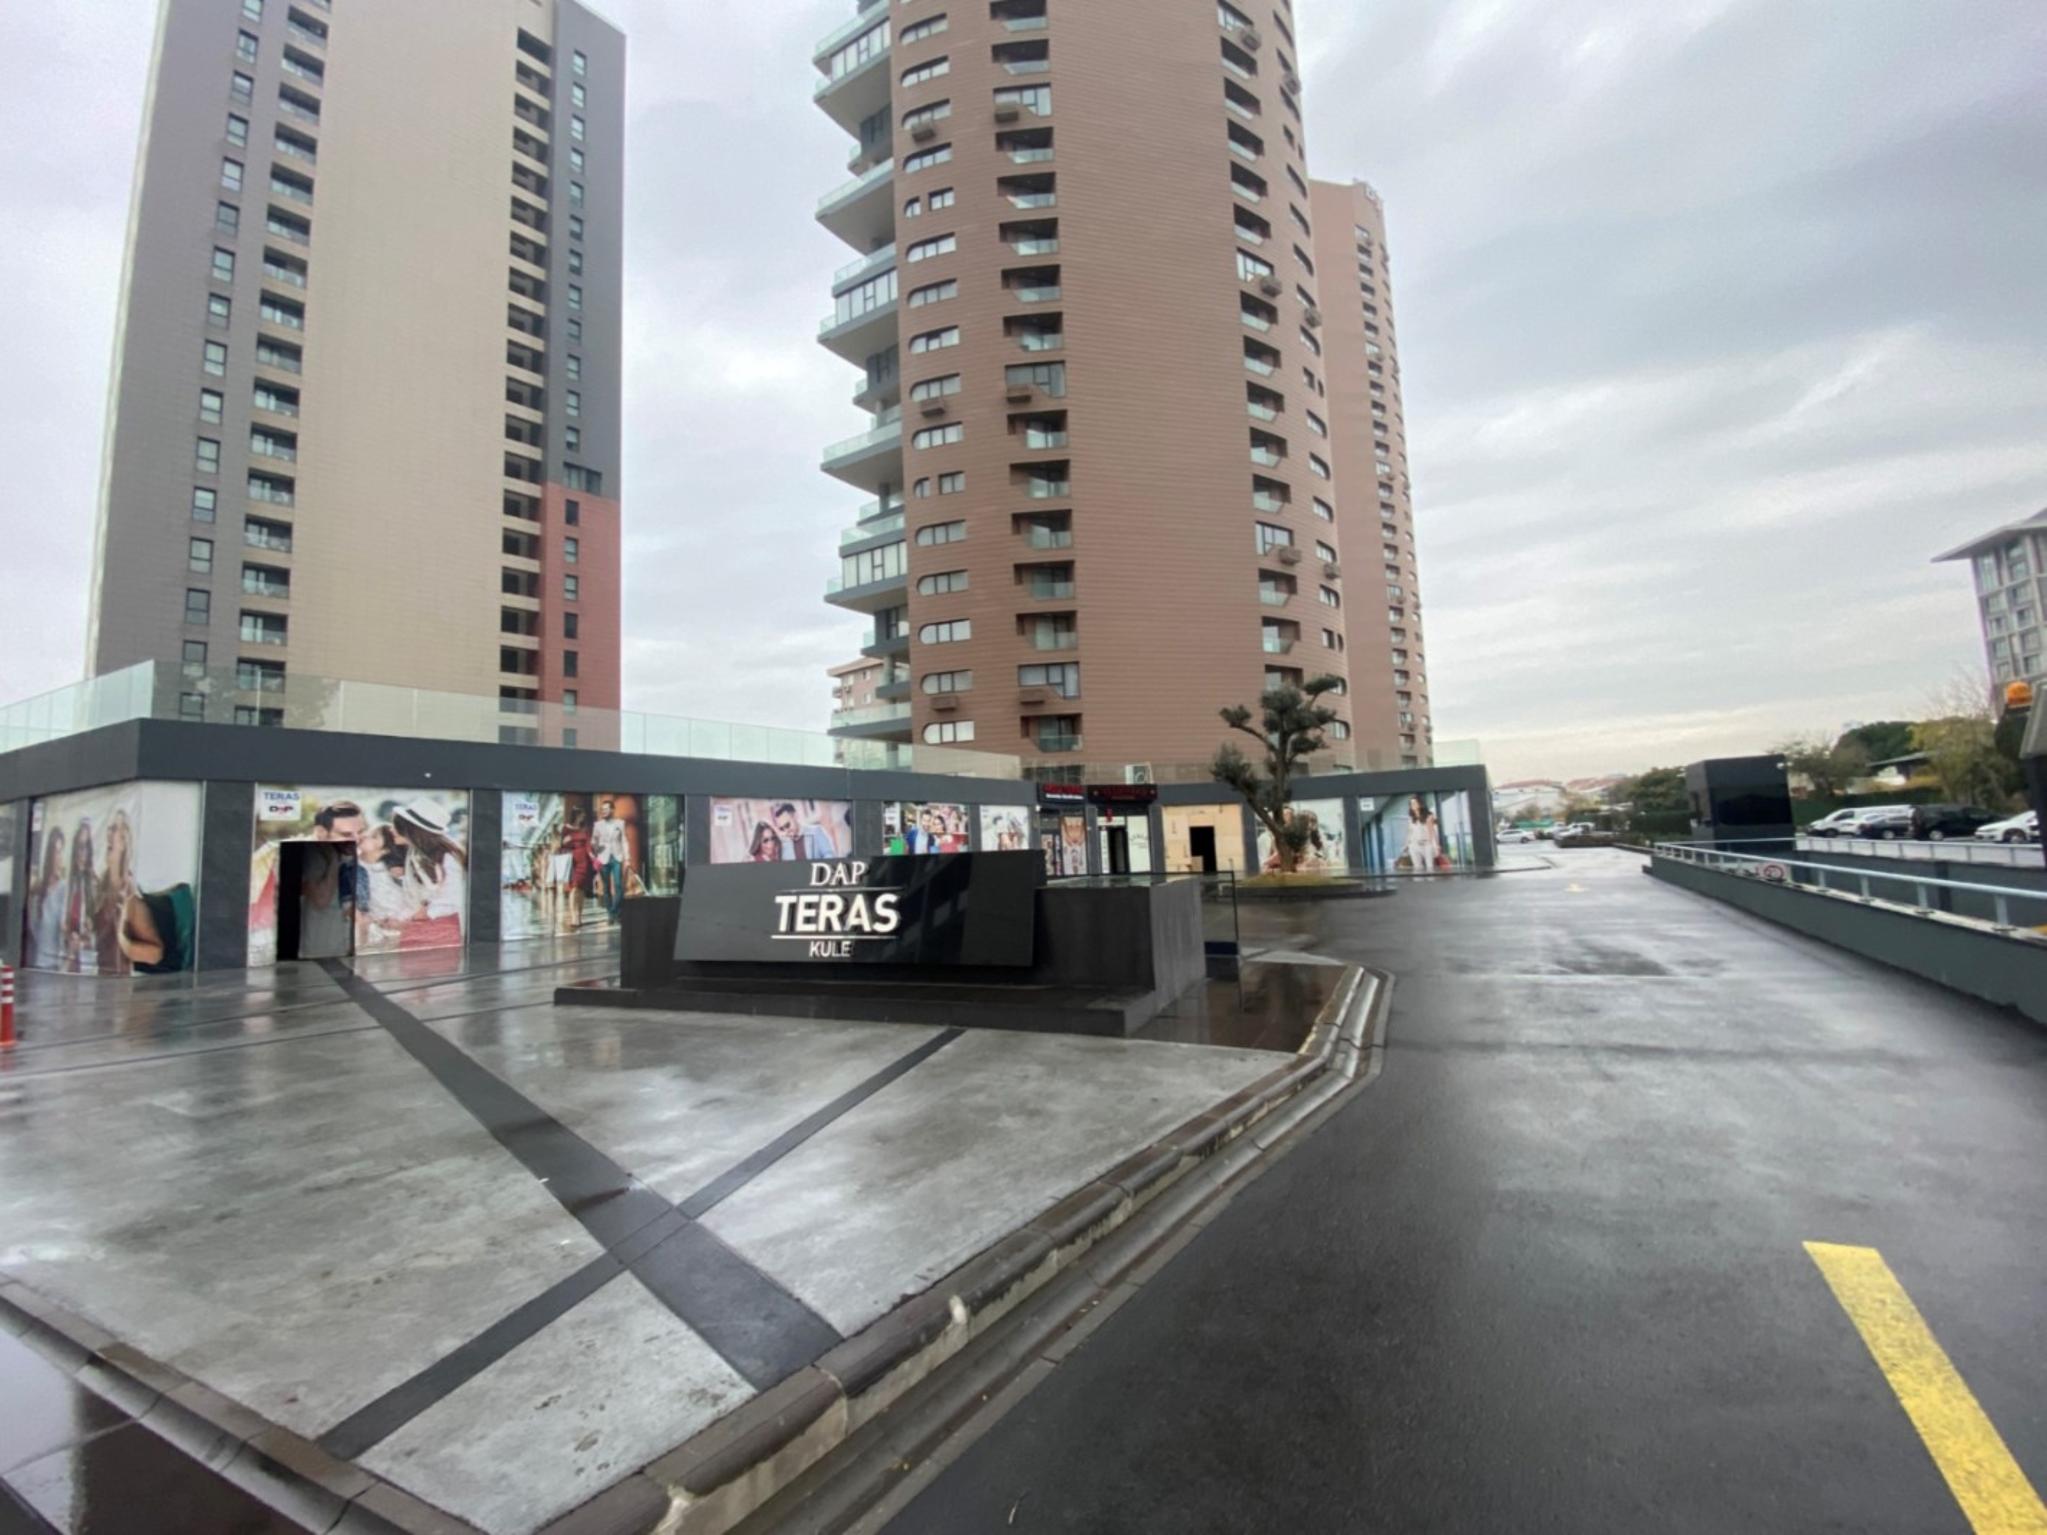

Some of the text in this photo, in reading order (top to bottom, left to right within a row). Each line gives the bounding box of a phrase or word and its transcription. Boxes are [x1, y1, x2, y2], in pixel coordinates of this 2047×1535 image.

[263, 791, 300, 801] TERAS
[809, 861, 866, 887] DAP
[774, 892, 900, 934] TERAS
[808, 940, 852, 958] KULE
